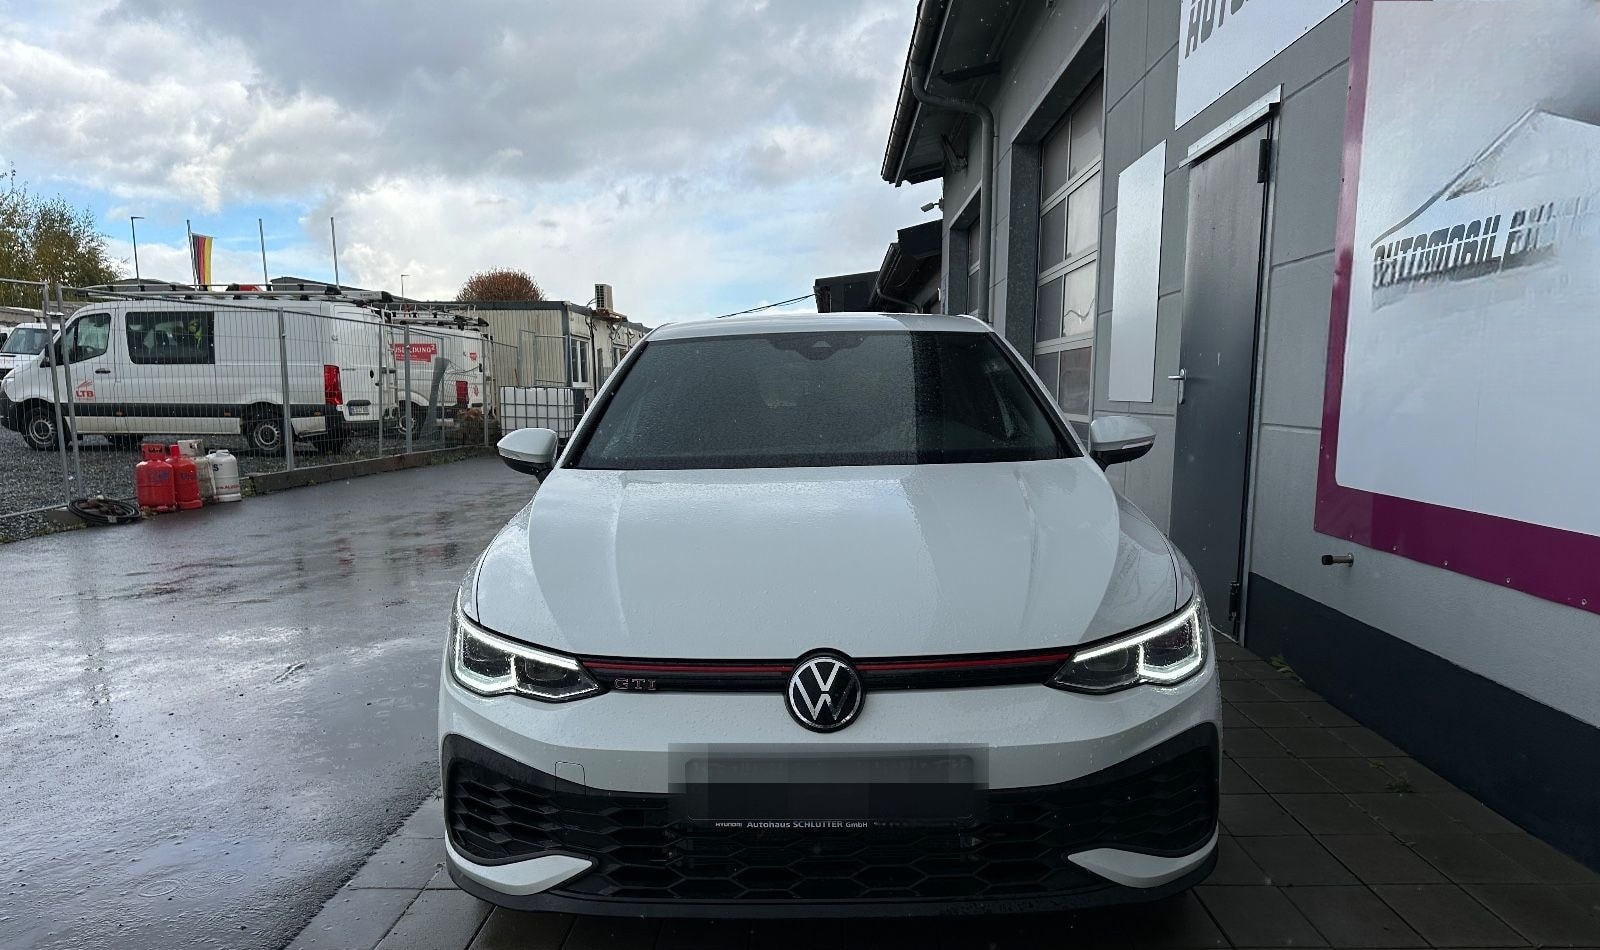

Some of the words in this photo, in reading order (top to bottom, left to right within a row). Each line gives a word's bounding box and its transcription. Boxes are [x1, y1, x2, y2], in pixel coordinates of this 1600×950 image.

[75, 390, 94, 398] LTB
[614, 678, 657, 691] GTI
[746, 820, 791, 828] Autohaus
